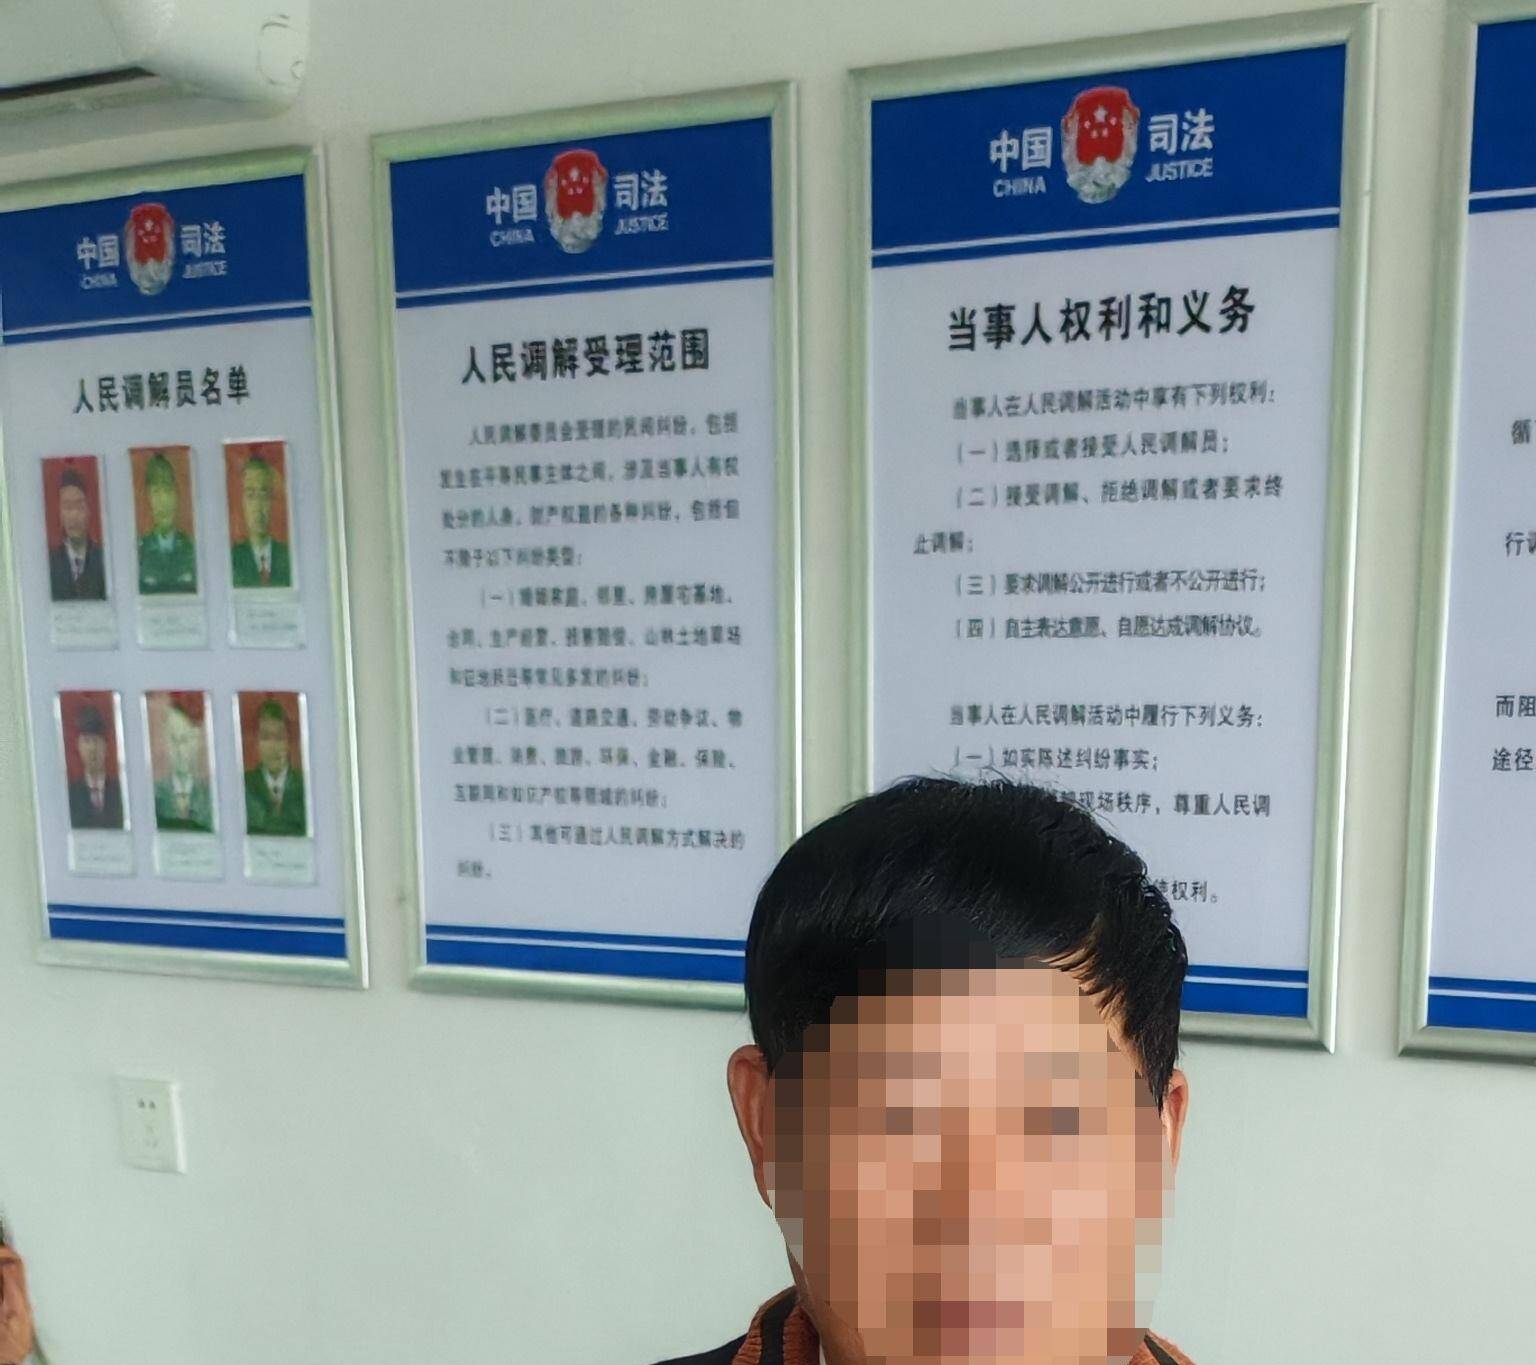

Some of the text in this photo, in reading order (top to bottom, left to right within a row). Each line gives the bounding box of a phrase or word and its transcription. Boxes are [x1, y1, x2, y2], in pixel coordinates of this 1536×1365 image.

[989, 108, 1215, 173] 中国 司法
[485, 168, 668, 224] 中国 司法
[993, 158, 1214, 198] CHINA JUSTICE
[77, 221, 226, 270] 中国 司法
[947, 284, 1256, 352] 当事人权利和义务
[462, 328, 709, 384] 人民调解受理范围
[73, 363, 250, 414] 人民调解员名单
